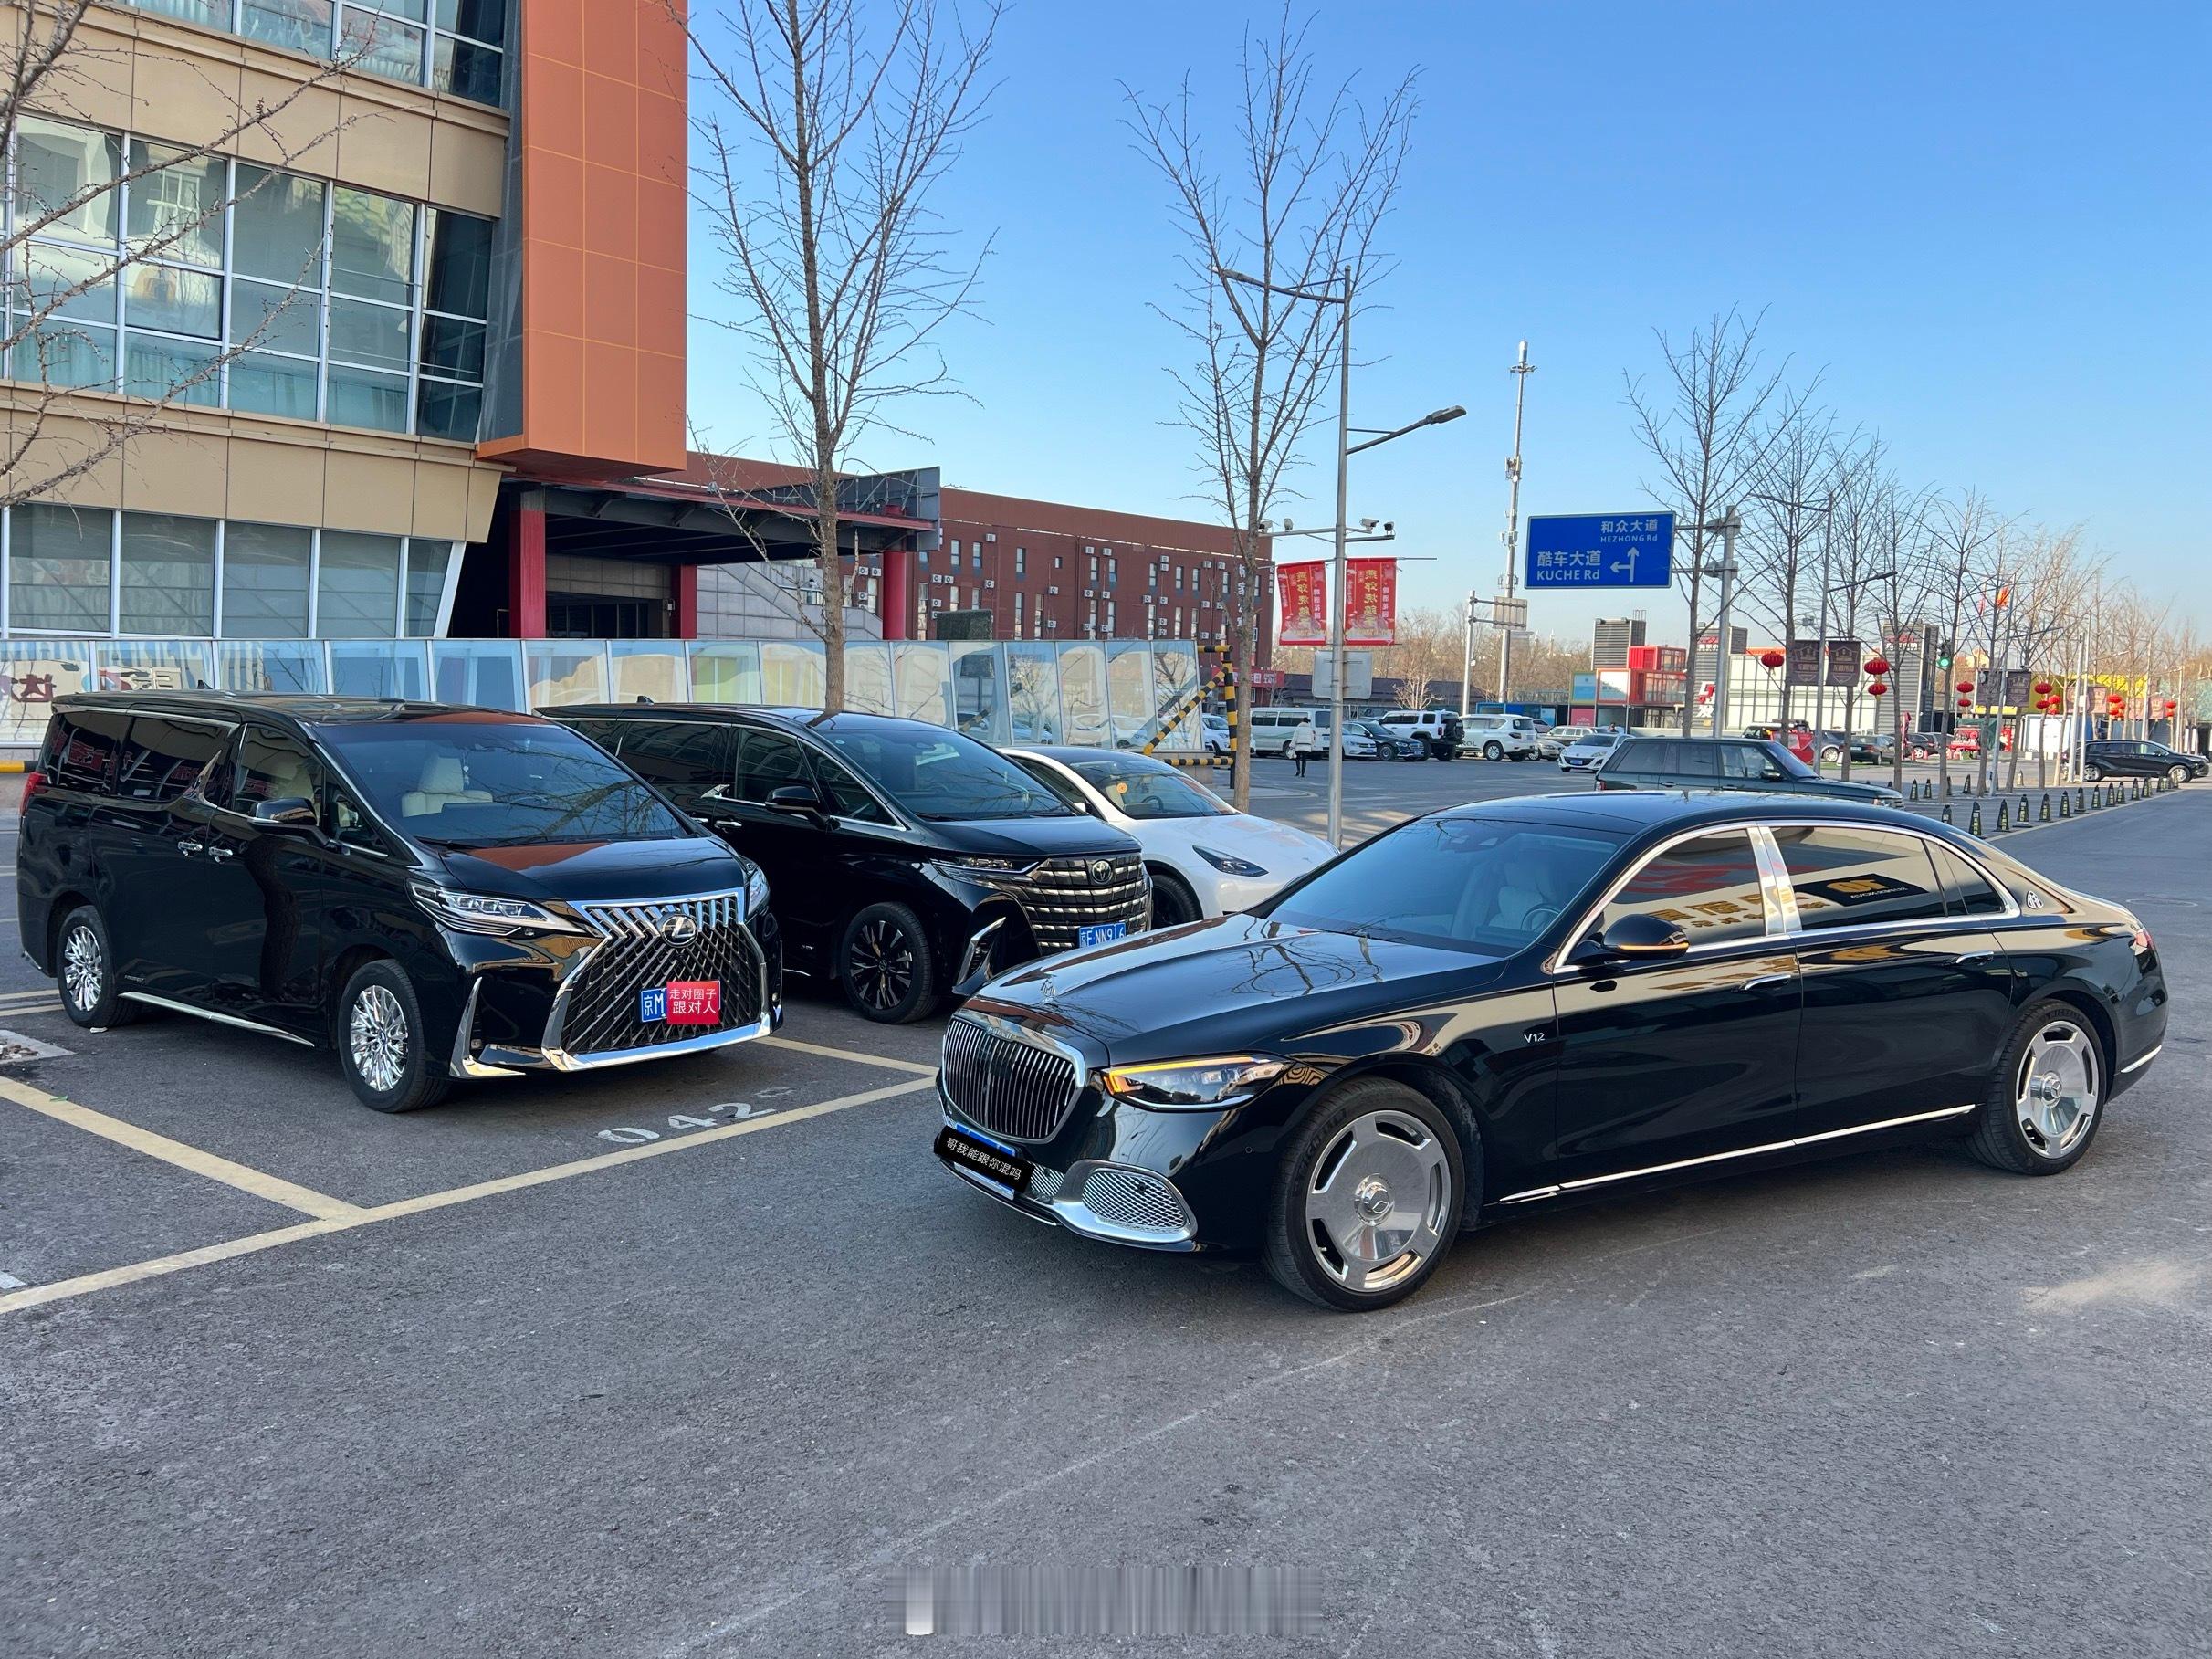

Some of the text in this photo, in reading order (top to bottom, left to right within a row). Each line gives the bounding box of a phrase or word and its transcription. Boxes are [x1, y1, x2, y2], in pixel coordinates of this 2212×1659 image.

[1600, 519, 1659, 534] 和众大道
[1600, 534, 1645, 543] HEZHONG
[1536, 550, 1602, 567] 酷车大道
[1536, 569, 1600, 581] KUCHE Rd
[1524, 1032, 1546, 1044] V12
[597, 1102, 776, 1144] 042
